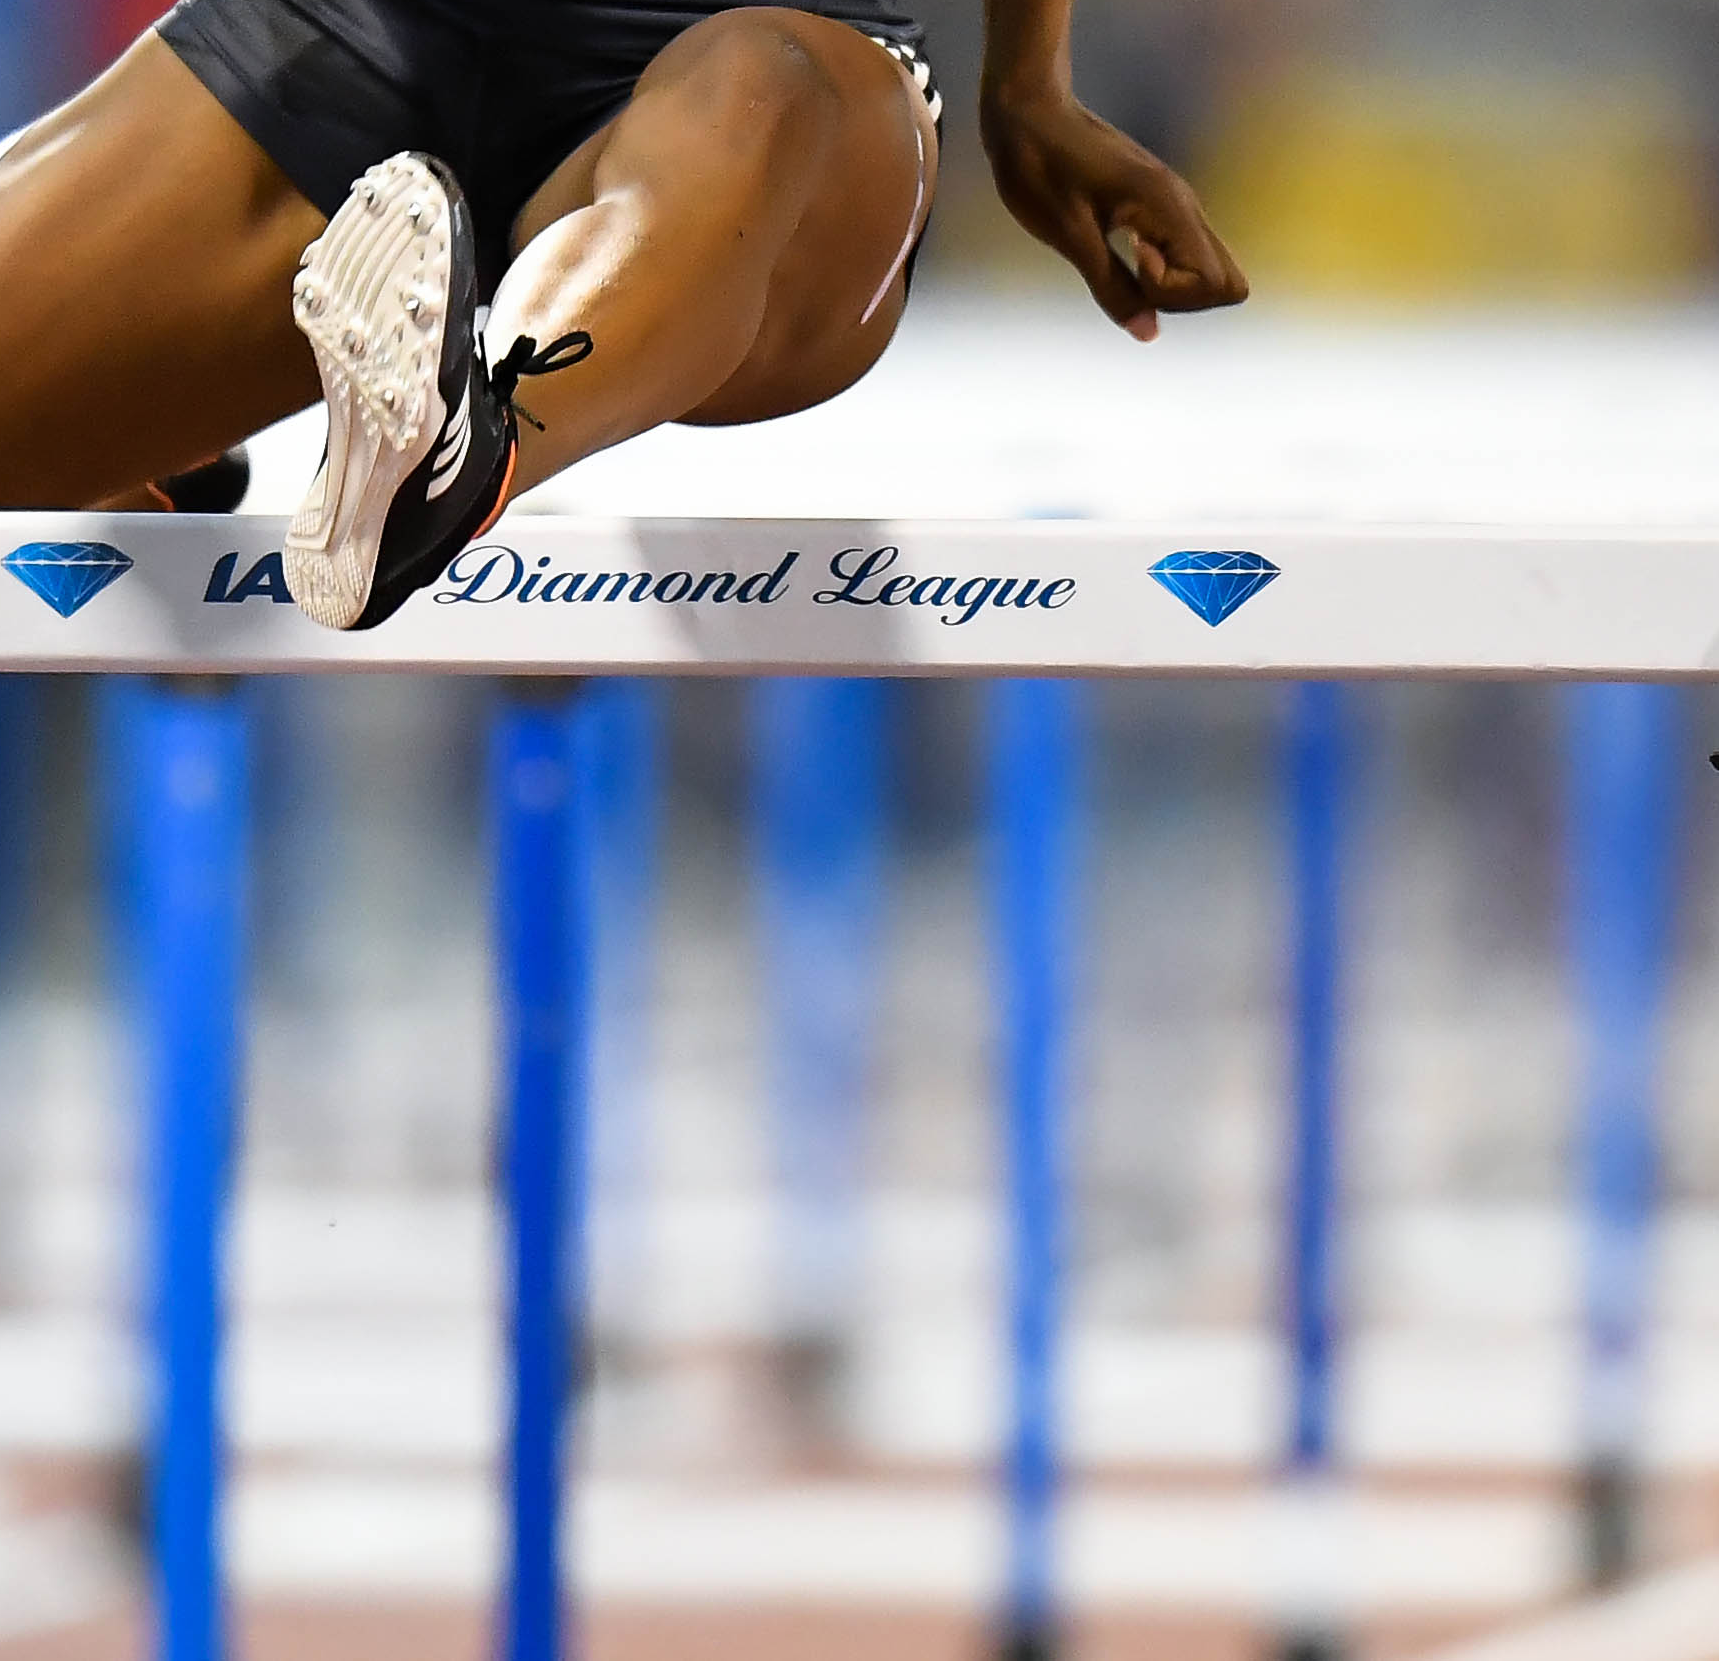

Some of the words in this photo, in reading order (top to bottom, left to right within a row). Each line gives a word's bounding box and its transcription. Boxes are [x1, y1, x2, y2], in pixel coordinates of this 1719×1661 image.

[202, 551, 297, 604] IA
[432, 544, 801, 605] Diamond
[812, 545, 1078, 626] League
